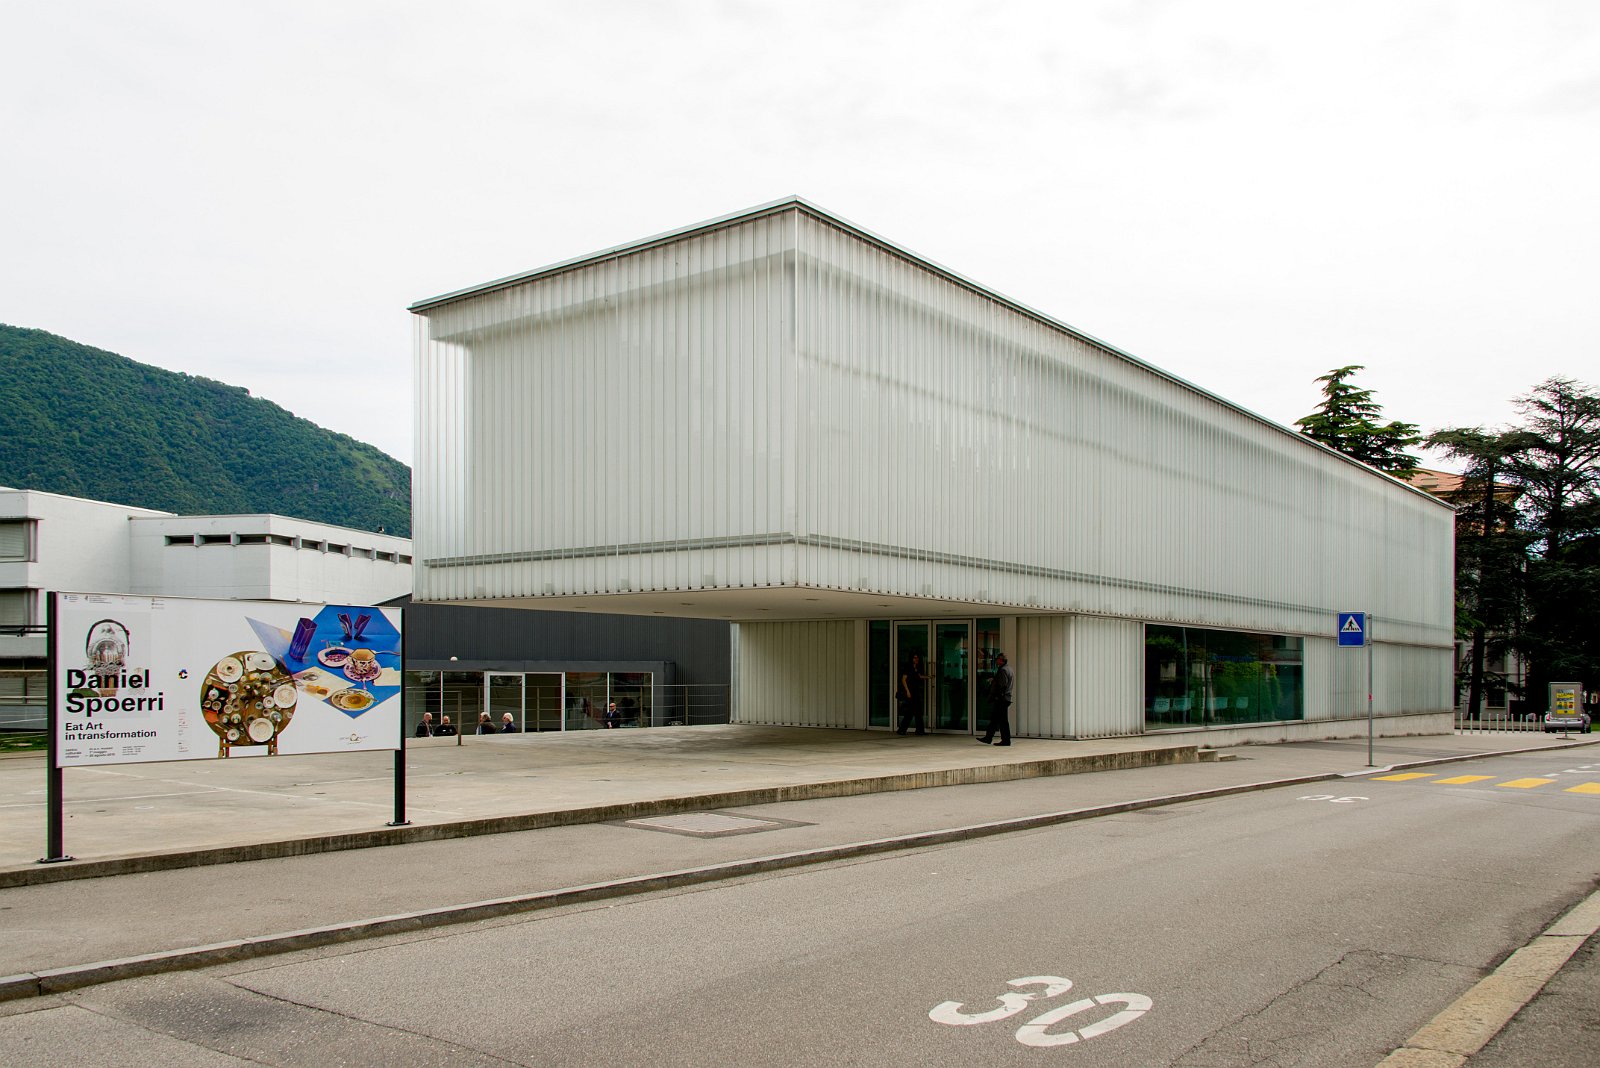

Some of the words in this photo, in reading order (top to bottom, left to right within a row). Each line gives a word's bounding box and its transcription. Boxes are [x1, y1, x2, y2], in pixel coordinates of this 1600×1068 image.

[67, 669, 149, 688] Daniel
[66, 692, 163, 717] Spoerri
[65, 722, 83, 731] Eat
[86, 722, 103, 731] Art
[65, 732, 75, 740] in
[78, 730, 157, 740] transformation
[928, 975, 1153, 1047] 30
